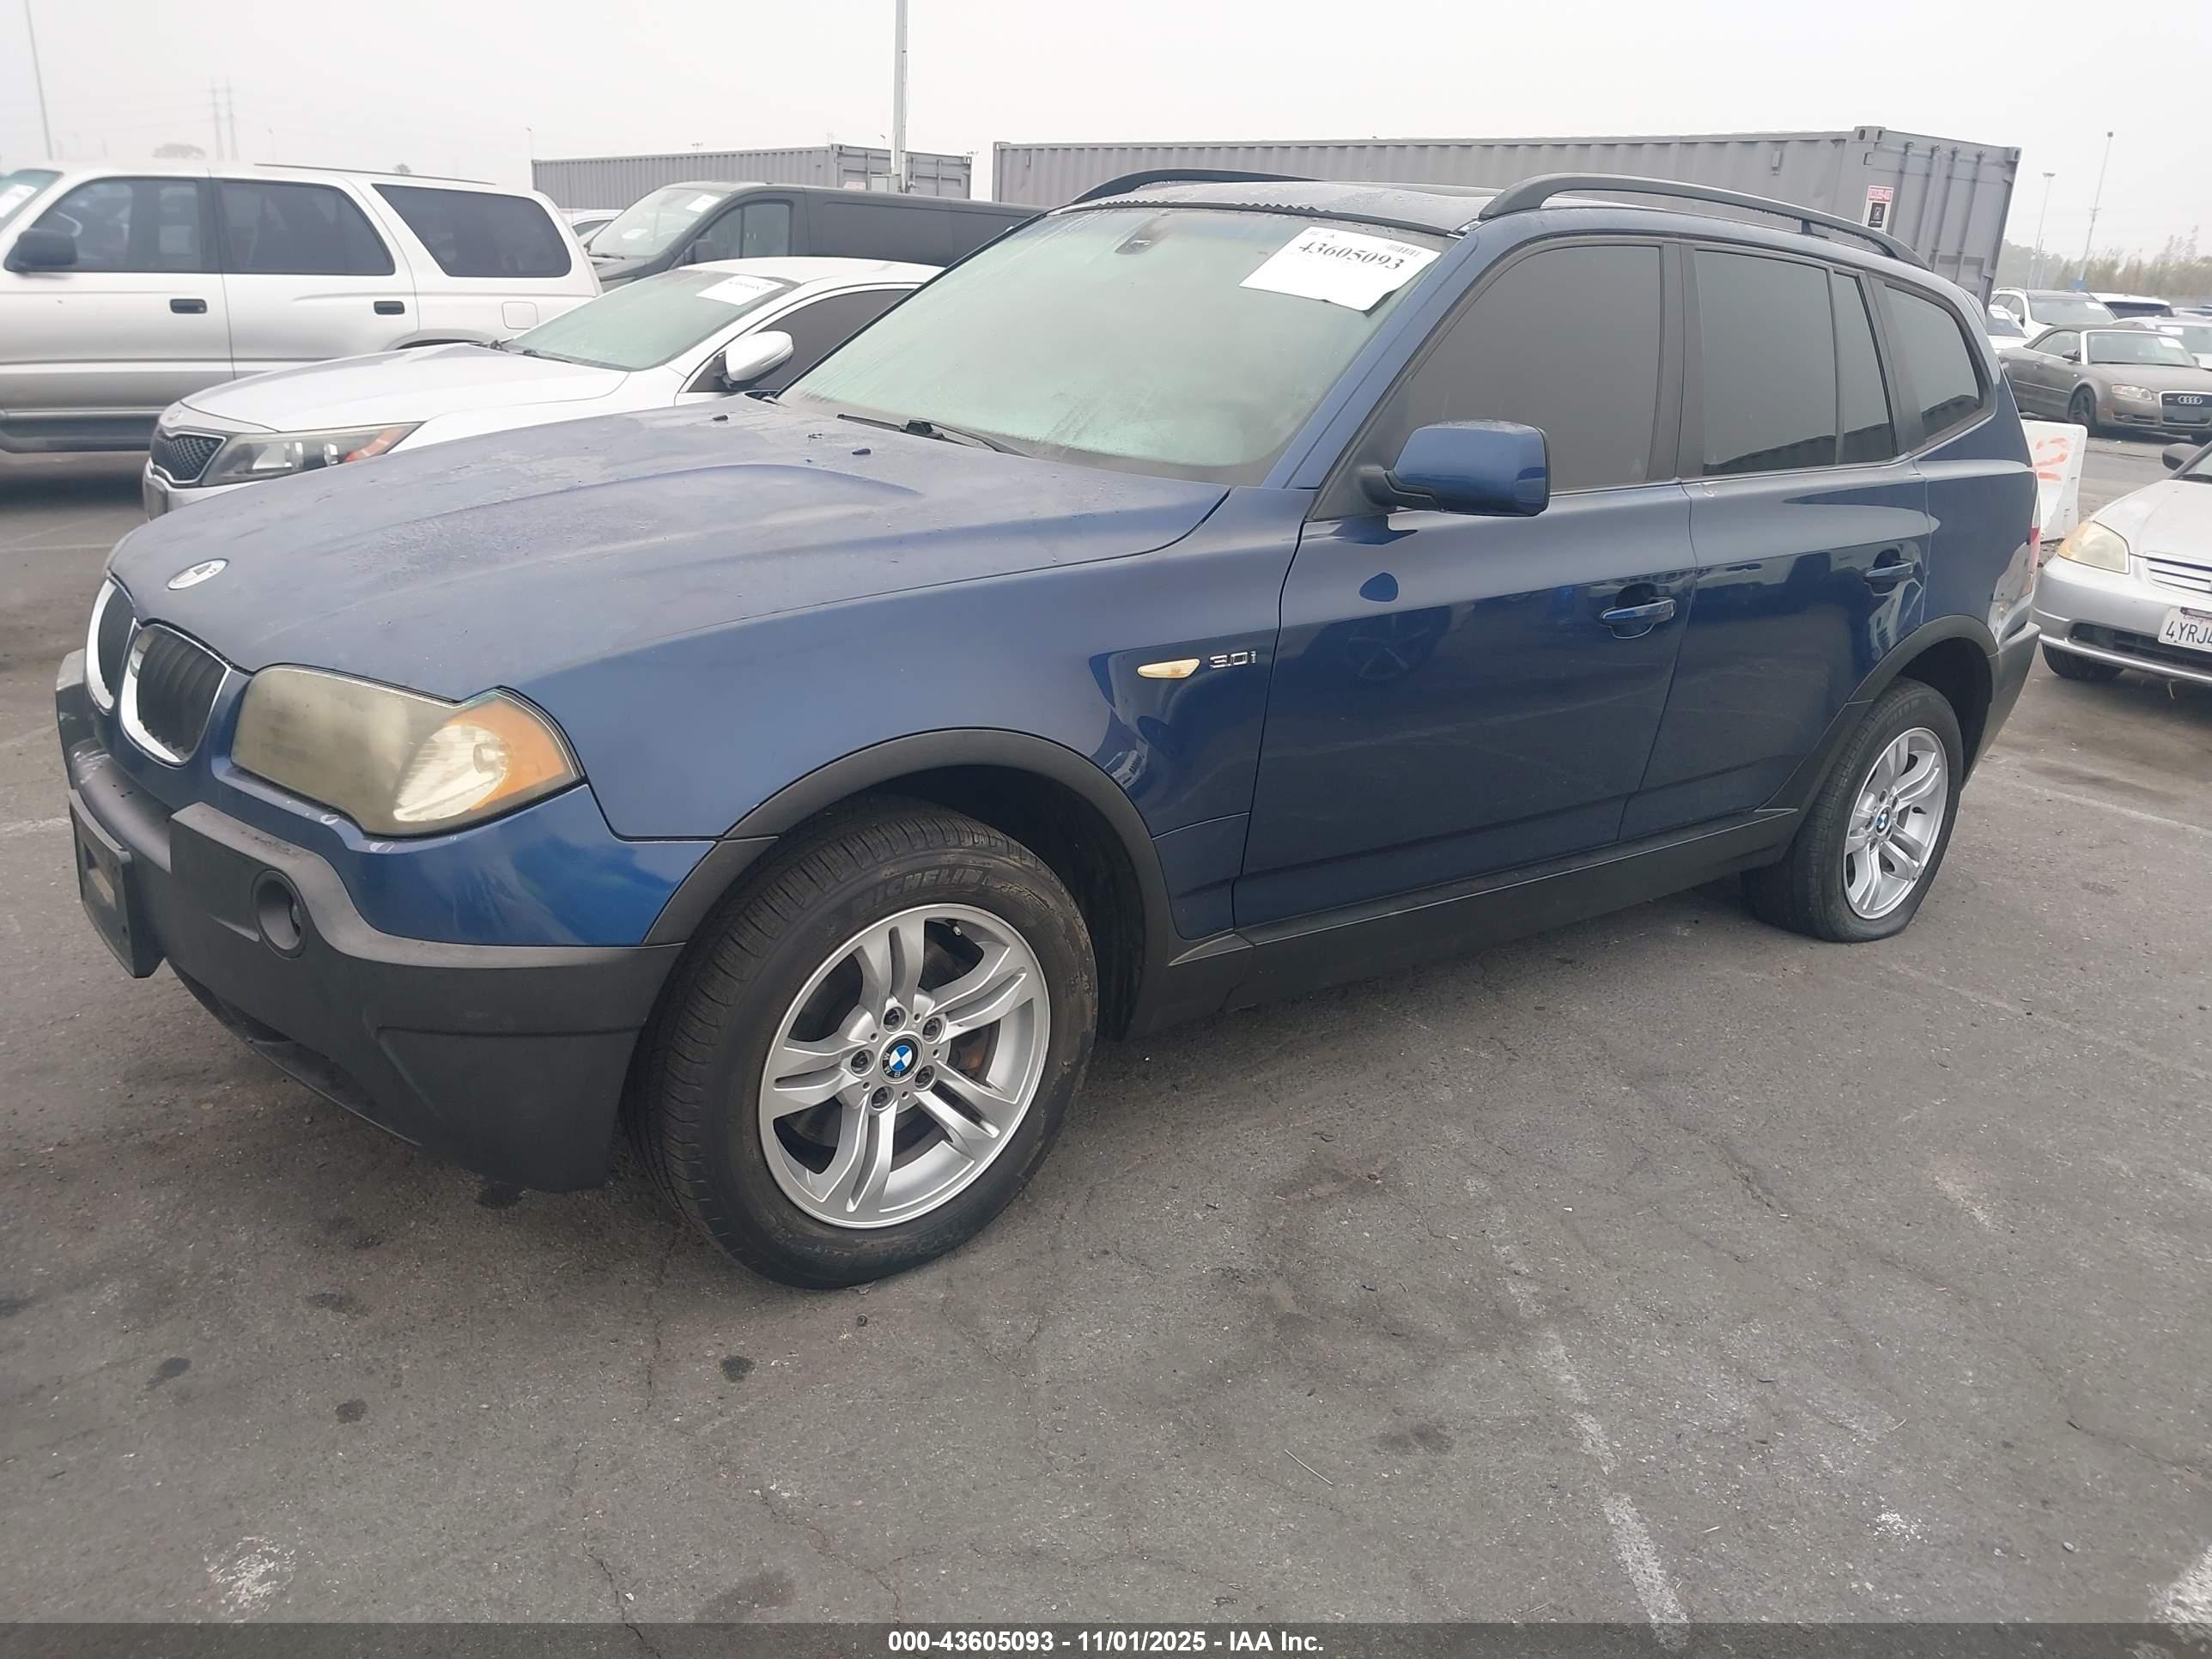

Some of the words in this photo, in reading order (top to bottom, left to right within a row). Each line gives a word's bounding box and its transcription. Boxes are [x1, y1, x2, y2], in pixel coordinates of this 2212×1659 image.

[1298, 240, 1406, 270] 43605093
[1209, 650, 1257, 670] 3.0i
[851, 867, 985, 910] MICHELIN
